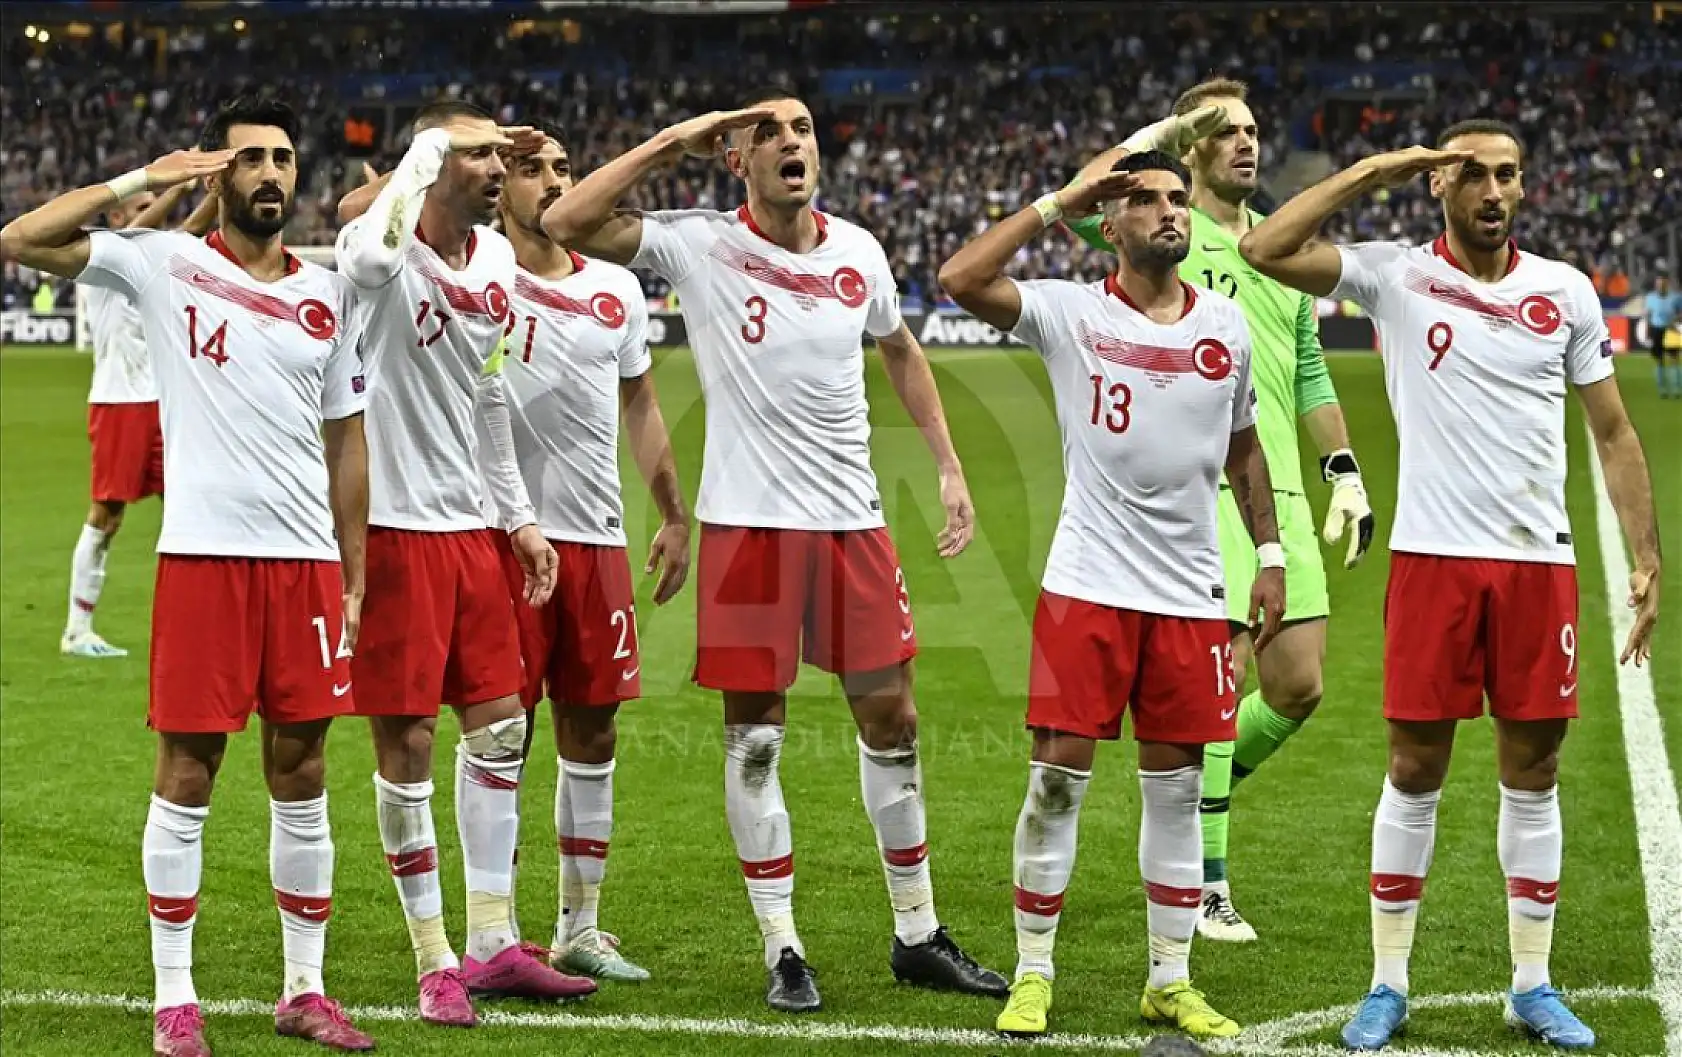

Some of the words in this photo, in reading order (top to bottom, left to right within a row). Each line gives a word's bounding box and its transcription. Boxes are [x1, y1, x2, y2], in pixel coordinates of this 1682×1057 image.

[0, 312, 71, 342] Fibre
[184, 304, 230, 368] 14
[741, 295, 768, 344] 3
[919, 311, 1002, 344] Avec
[1427, 321, 1454, 371] 9
[1089, 374, 1132, 434] 13
[1561, 623, 1575, 674] 9
